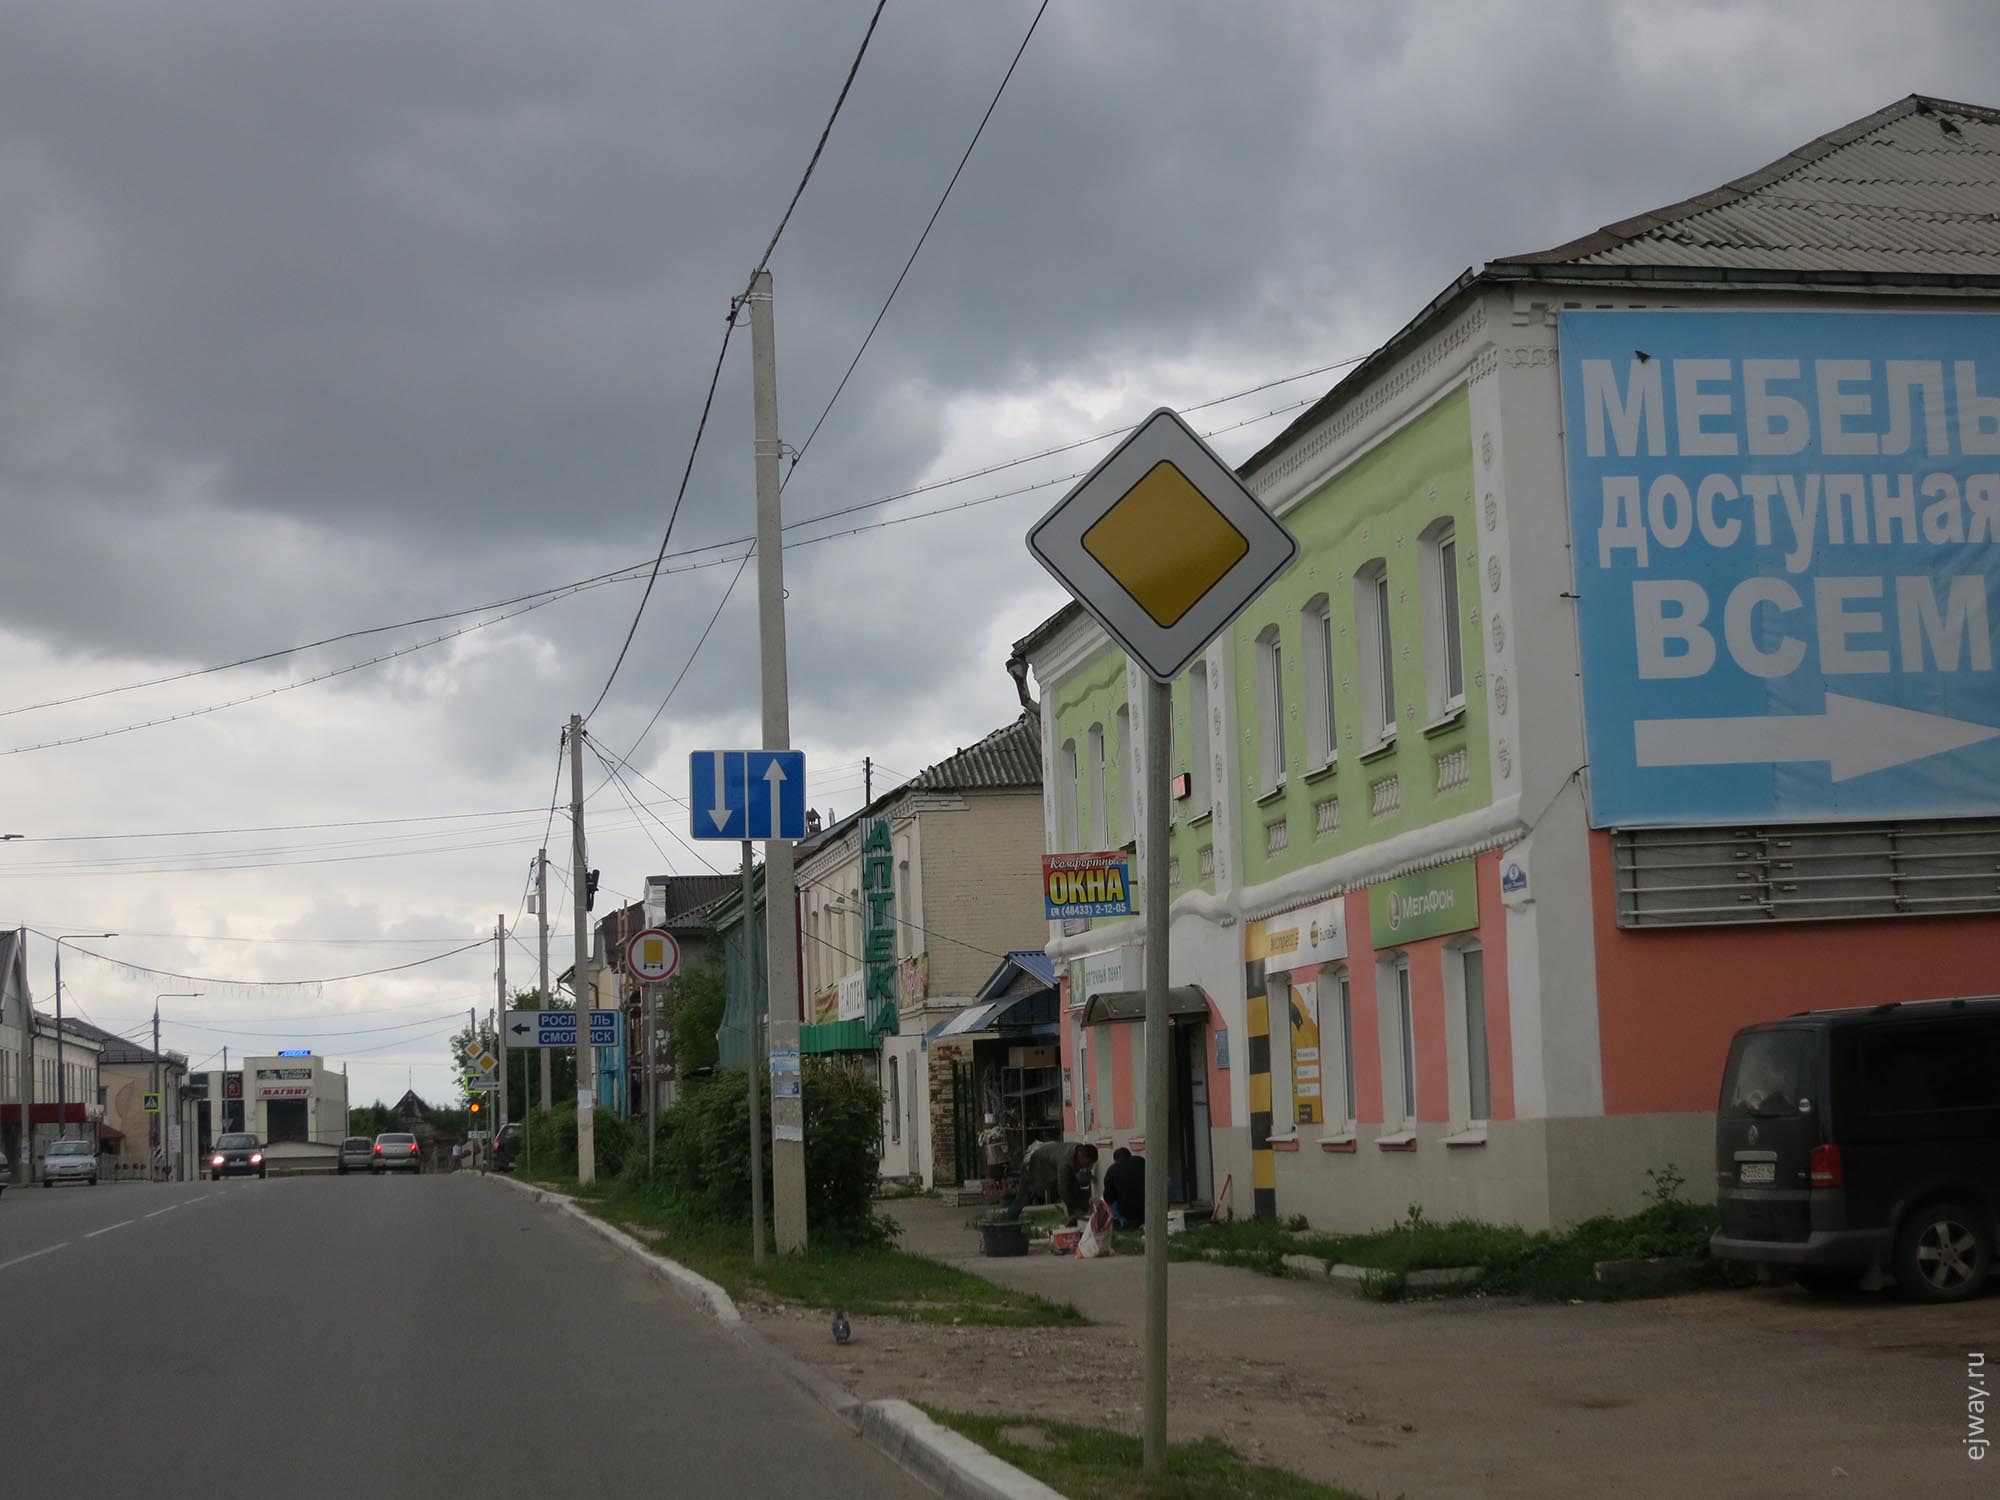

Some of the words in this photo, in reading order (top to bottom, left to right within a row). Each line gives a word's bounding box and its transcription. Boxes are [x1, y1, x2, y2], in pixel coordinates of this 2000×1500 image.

[1580, 358, 2000, 457] МЕБЕЛЬ
[1631, 574, 1994, 681] ВСЕМ
[1047, 854, 1121, 870] Комфортные
[1048, 867, 1127, 906] ОКНА
[1061, 904, 1093, 918] (48433)
[1095, 902, 1127, 914] 2-12-05
[863, 819, 900, 1037] АПТЕКА
[541, 1031, 612, 1043] СМОЛНСК
[261, 1087, 309, 1097] МАГНИТ
